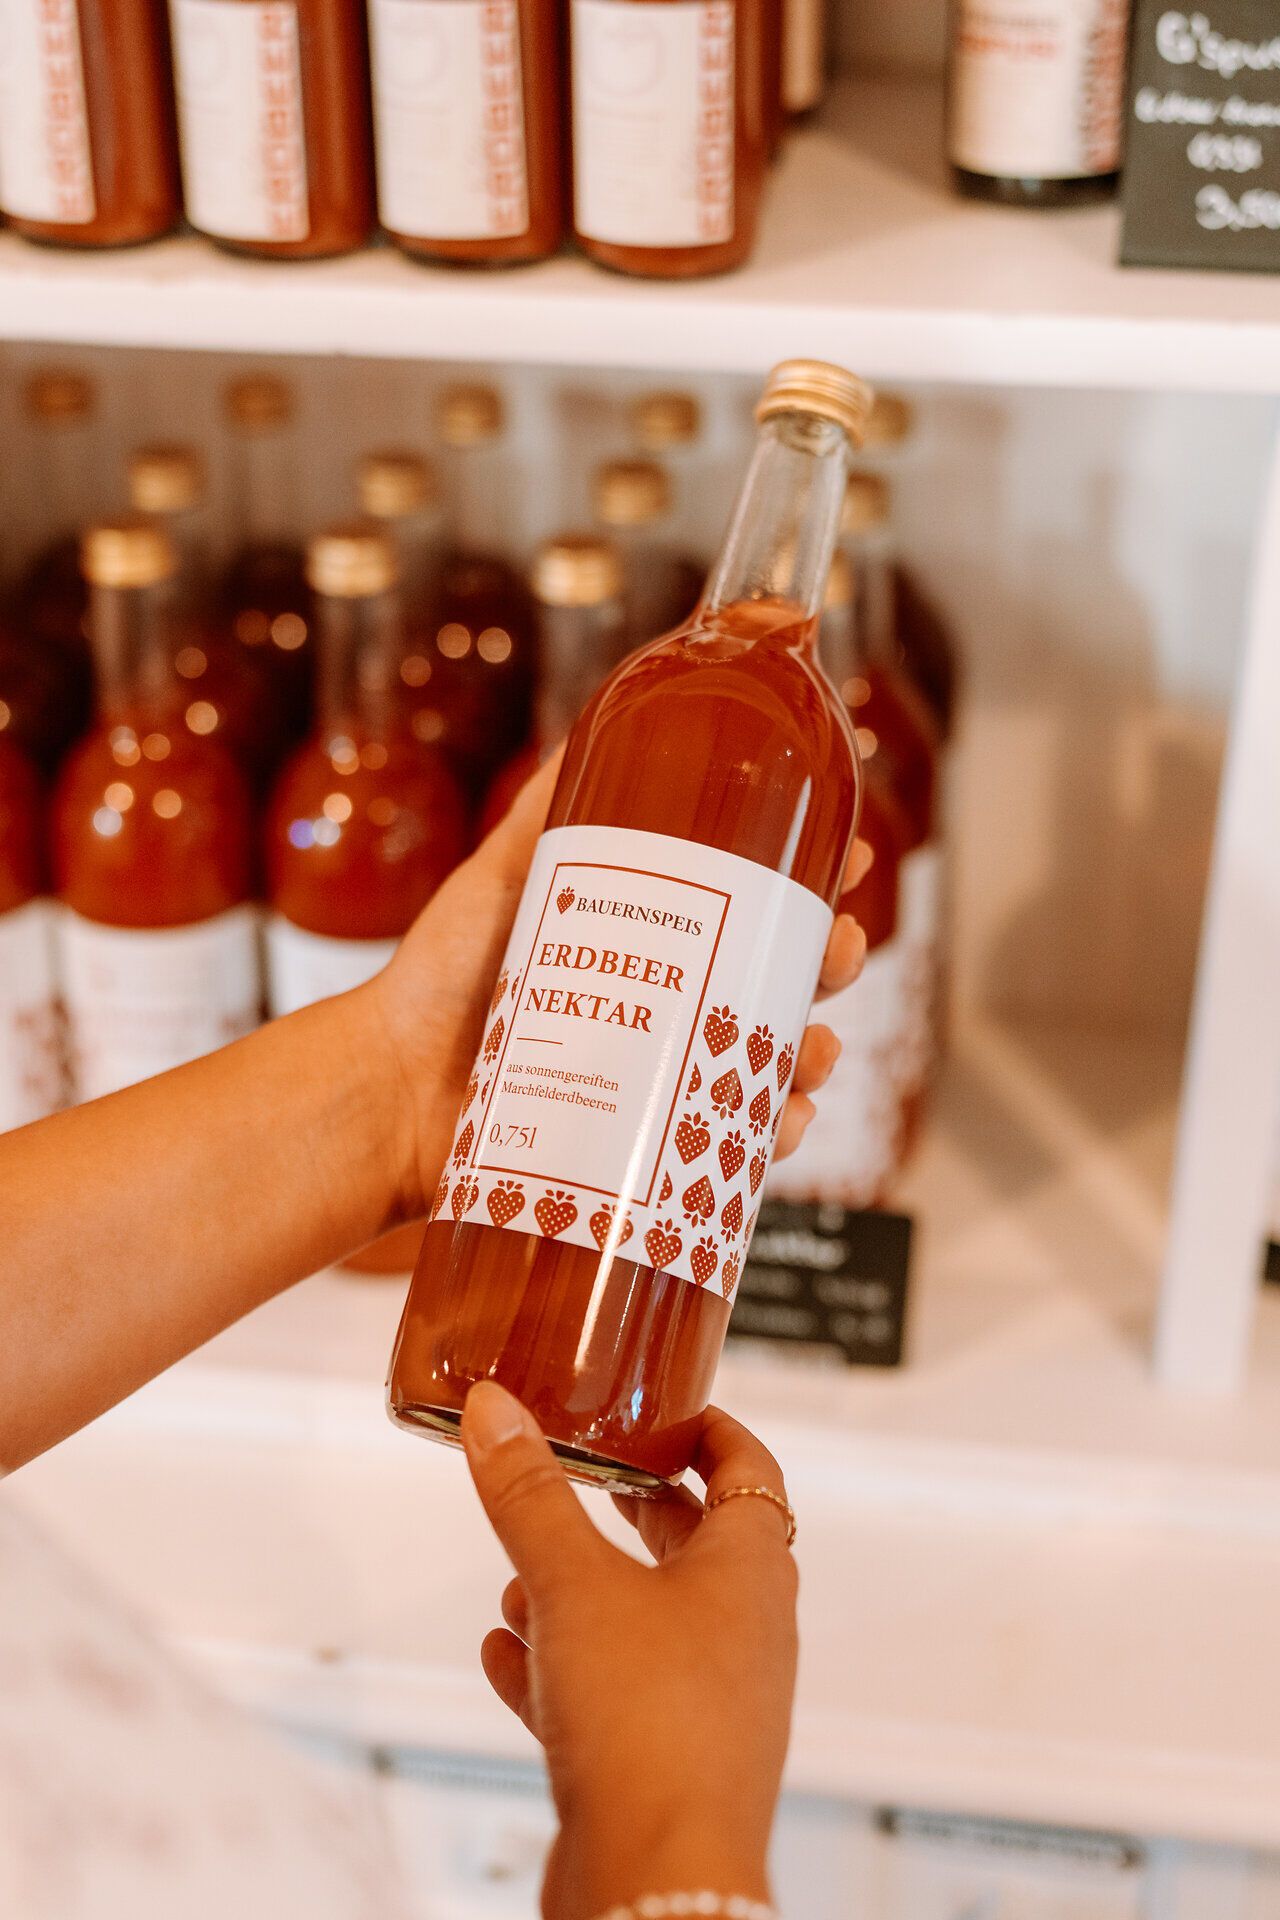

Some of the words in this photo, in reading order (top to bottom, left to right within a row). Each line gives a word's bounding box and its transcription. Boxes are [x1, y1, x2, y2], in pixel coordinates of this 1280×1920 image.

[576, 897, 703, 936] BAUERNSPEIS
[536, 943, 685, 993] ERDBEER
[523, 988, 653, 1033] NEKTAR
[506, 1063, 524, 1074] aus
[525, 1064, 620, 1092] sonnengereiften
[501, 1081, 617, 1113] Marchfelderdbeeren
[489, 1123, 538, 1149] 0,75l
